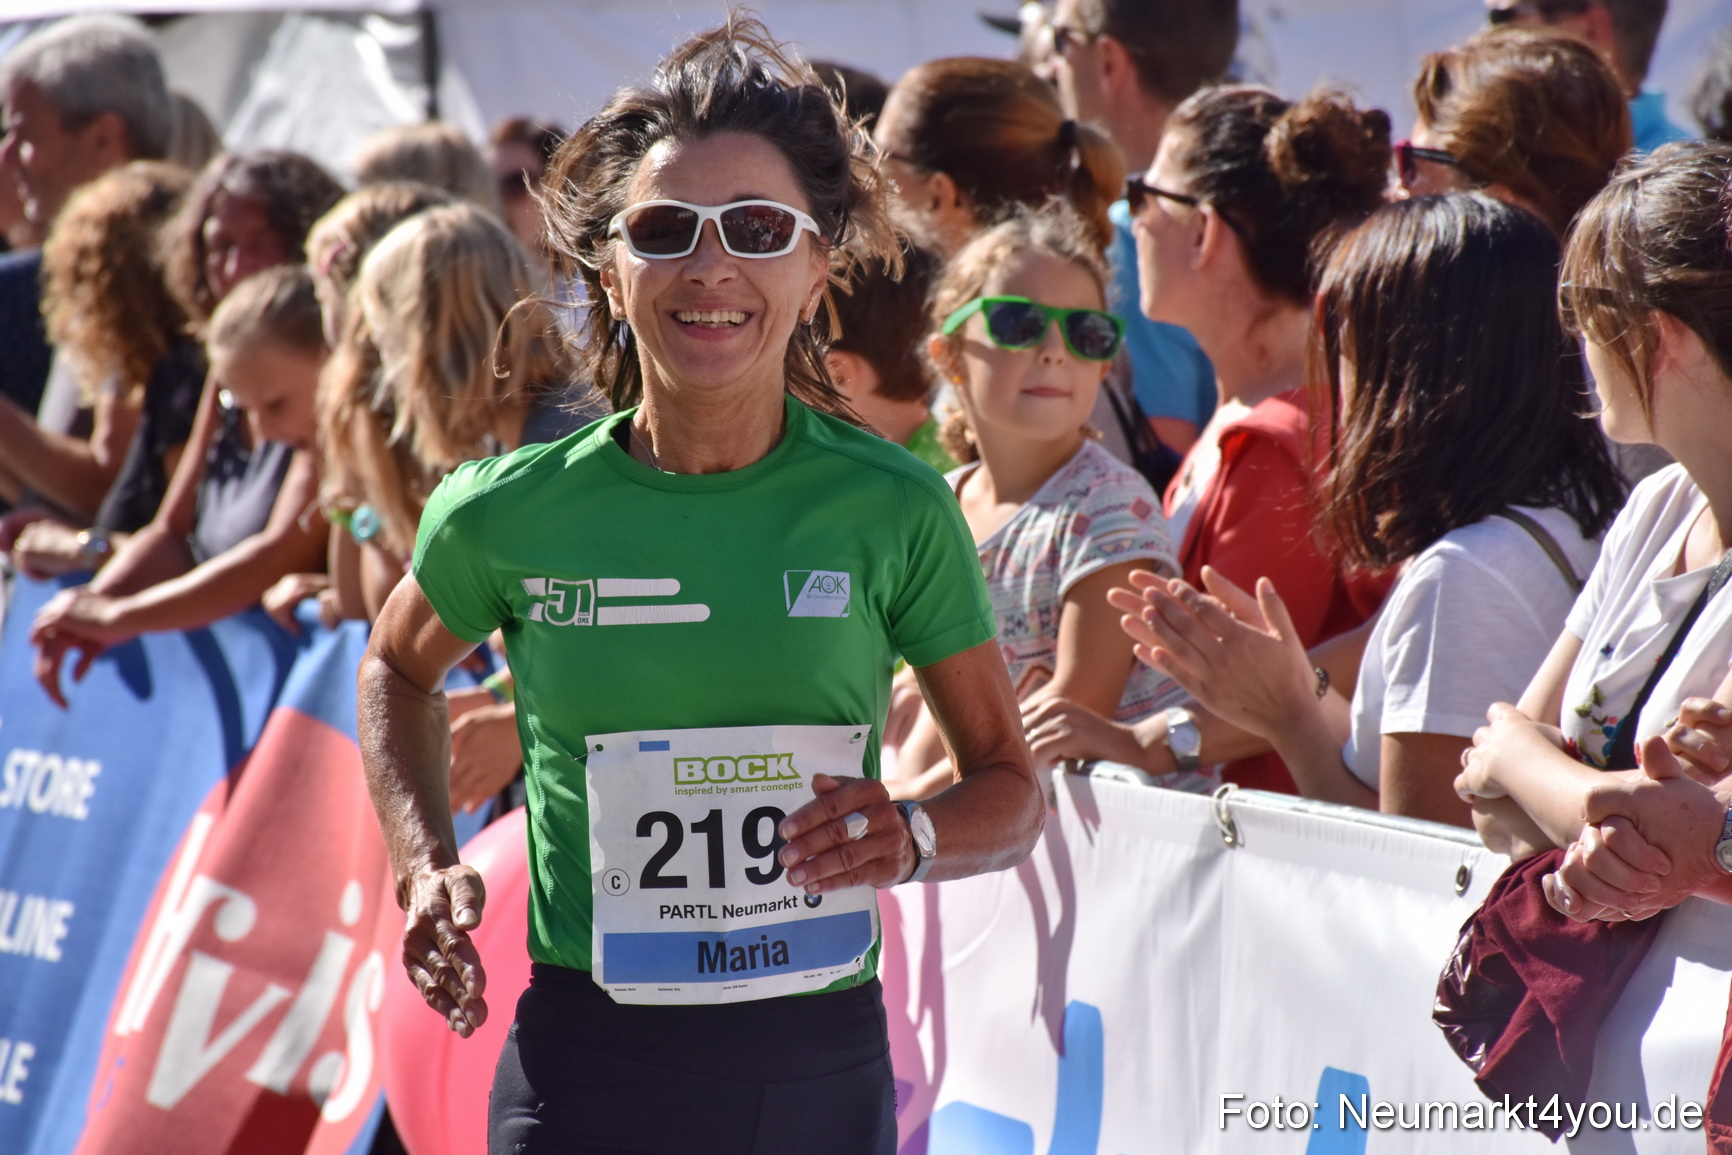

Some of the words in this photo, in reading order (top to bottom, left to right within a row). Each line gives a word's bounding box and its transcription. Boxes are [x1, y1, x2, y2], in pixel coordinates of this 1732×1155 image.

[808, 575, 846, 594] AOK
[674, 753, 801, 785] BOCK
[0, 748, 102, 820] STORE
[674, 786, 713, 797] inspired
[716, 786, 728, 795] by
[730, 785, 758, 794] smart
[761, 782, 803, 792] concepts
[611, 875, 621, 890] C
[659, 904, 718, 919] PARTL
[722, 894, 798, 919] Neumarkt
[0, 890, 75, 962] LINE
[697, 934, 790, 974] Maria
